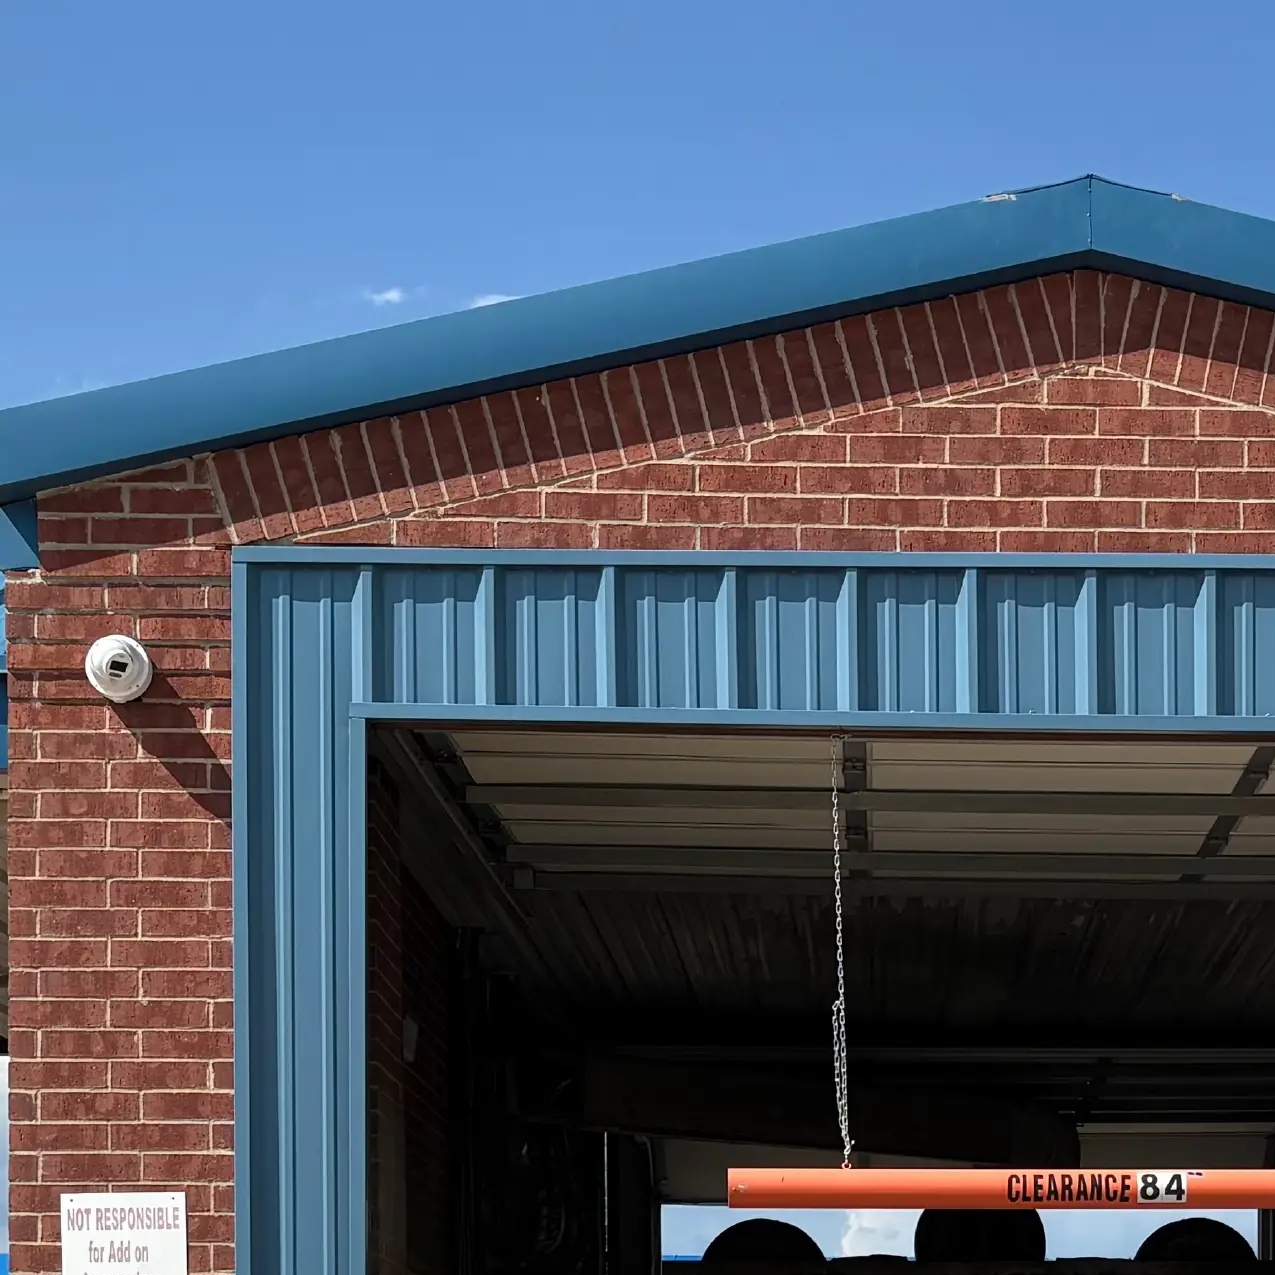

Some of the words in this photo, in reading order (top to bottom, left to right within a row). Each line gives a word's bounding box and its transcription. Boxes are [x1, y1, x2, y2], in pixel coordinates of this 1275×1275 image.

[1007, 1174, 1131, 1202] CLEARANCE
[67, 1209, 92, 1231] NOT
[96, 1207, 180, 1230] RESPONSIBLE
[89, 1242, 104, 1263] for
[108, 1241, 131, 1263] Add
[135, 1244, 149, 1262] on
